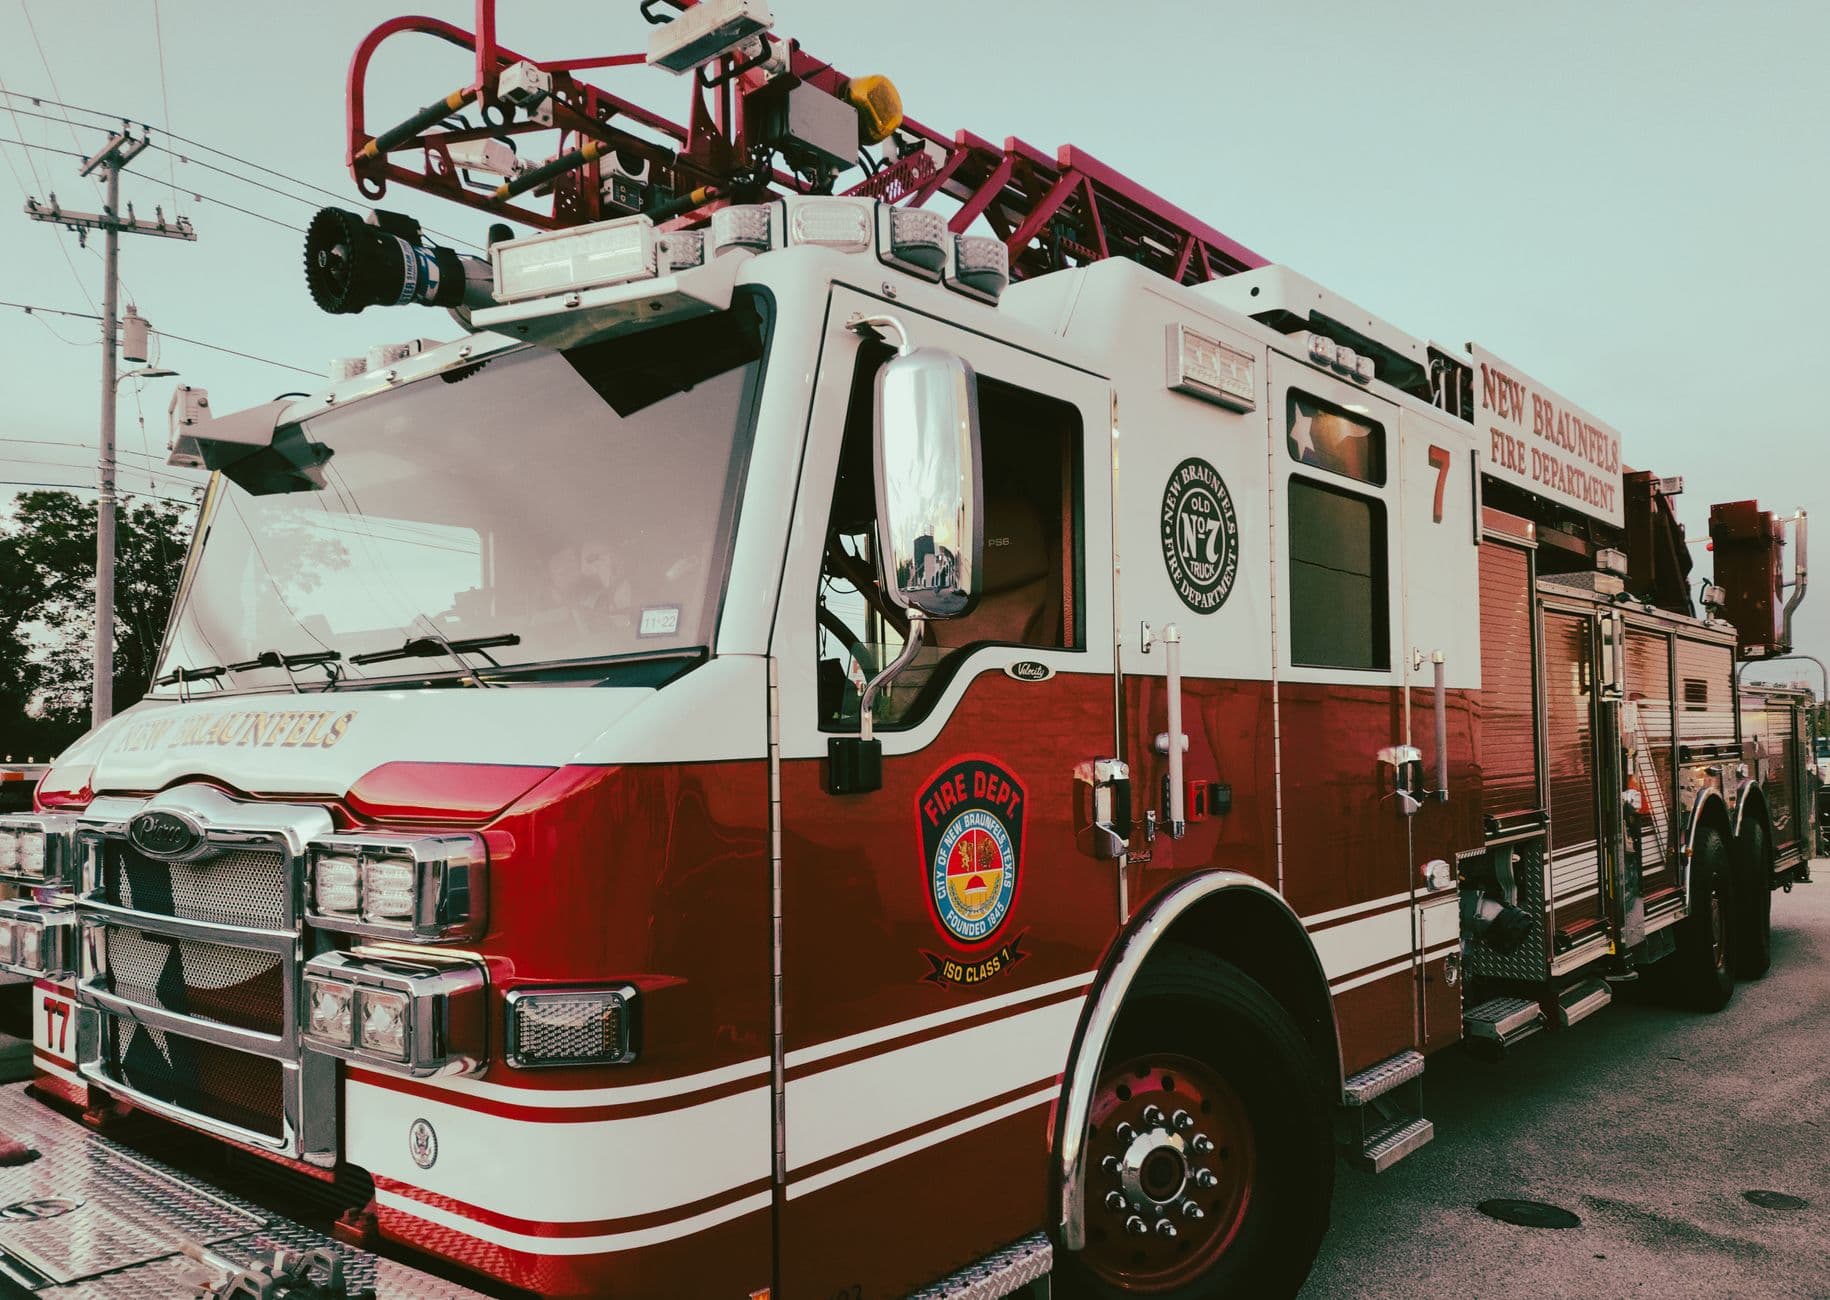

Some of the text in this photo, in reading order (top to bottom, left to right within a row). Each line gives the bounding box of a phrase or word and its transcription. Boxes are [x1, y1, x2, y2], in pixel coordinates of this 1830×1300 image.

[1480, 362, 1619, 476] NEW BRAUNFELS
[1427, 444, 1451, 525] 7
[1489, 426, 1616, 513] FIRE DEPARTMENT
[1163, 464, 1236, 535] NEW BRAUNFELS
[1191, 496, 1210, 513] OLD
[1163, 537, 1236, 609] FIRE DEPARTMENT
[1189, 560, 1215, 579] TRUCK
[1018, 663, 1045, 679] Velocity
[116, 710, 358, 752] NEW BRAUNFELS
[924, 772, 968, 827] FIRE
[139, 815, 182, 844] Pierce
[944, 822, 963, 846] NEW
[937, 849, 949, 867] OF
[1001, 847, 1013, 889] TEXAS
[937, 870, 947, 900] CITY
[945, 902, 1006, 937] FOUNDED 1845
[943, 948, 1010, 984] ISO CLASS 1
[43, 996, 70, 1054] T7
